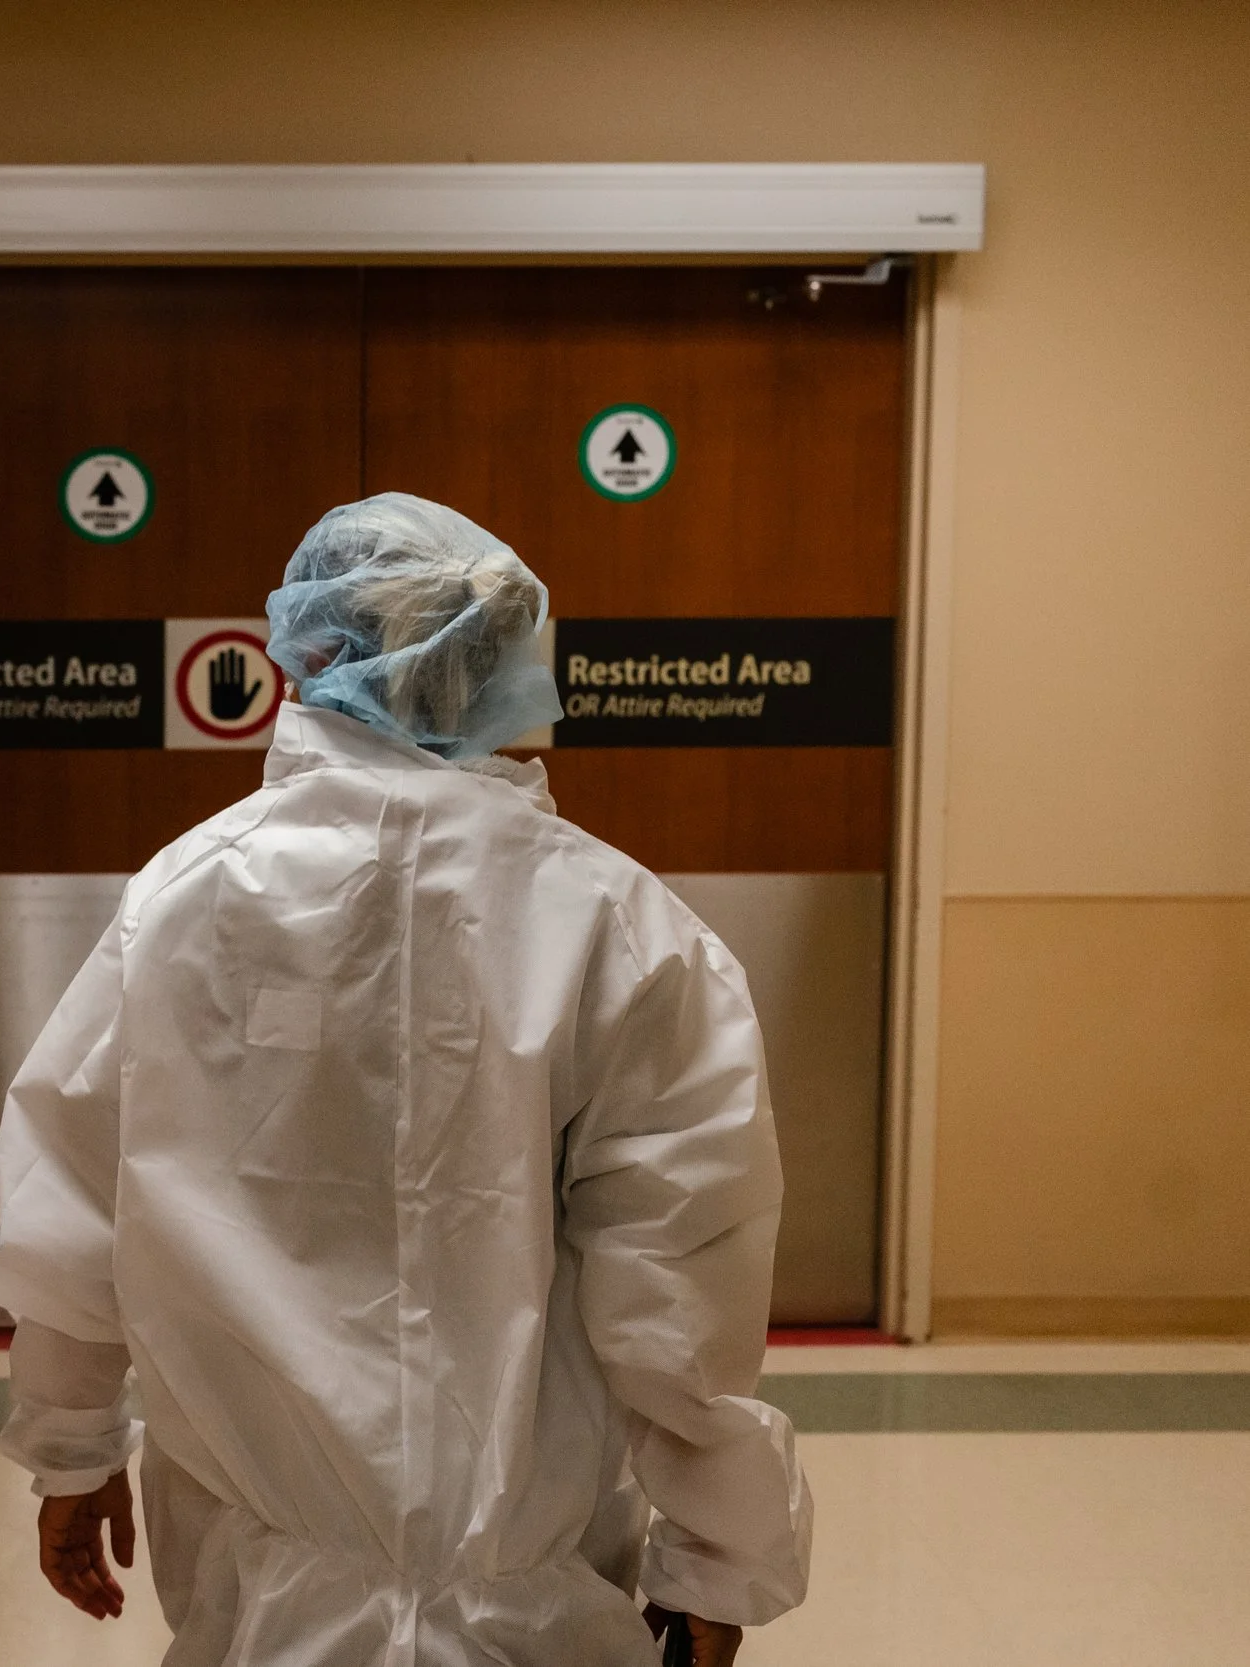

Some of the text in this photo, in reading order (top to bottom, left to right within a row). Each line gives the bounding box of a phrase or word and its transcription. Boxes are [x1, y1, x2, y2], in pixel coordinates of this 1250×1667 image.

[64, 656, 137, 687] Area
[568, 653, 812, 686] Restricted Area
[43, 695, 142, 724] Required
[566, 692, 766, 722] OR Attire Required
